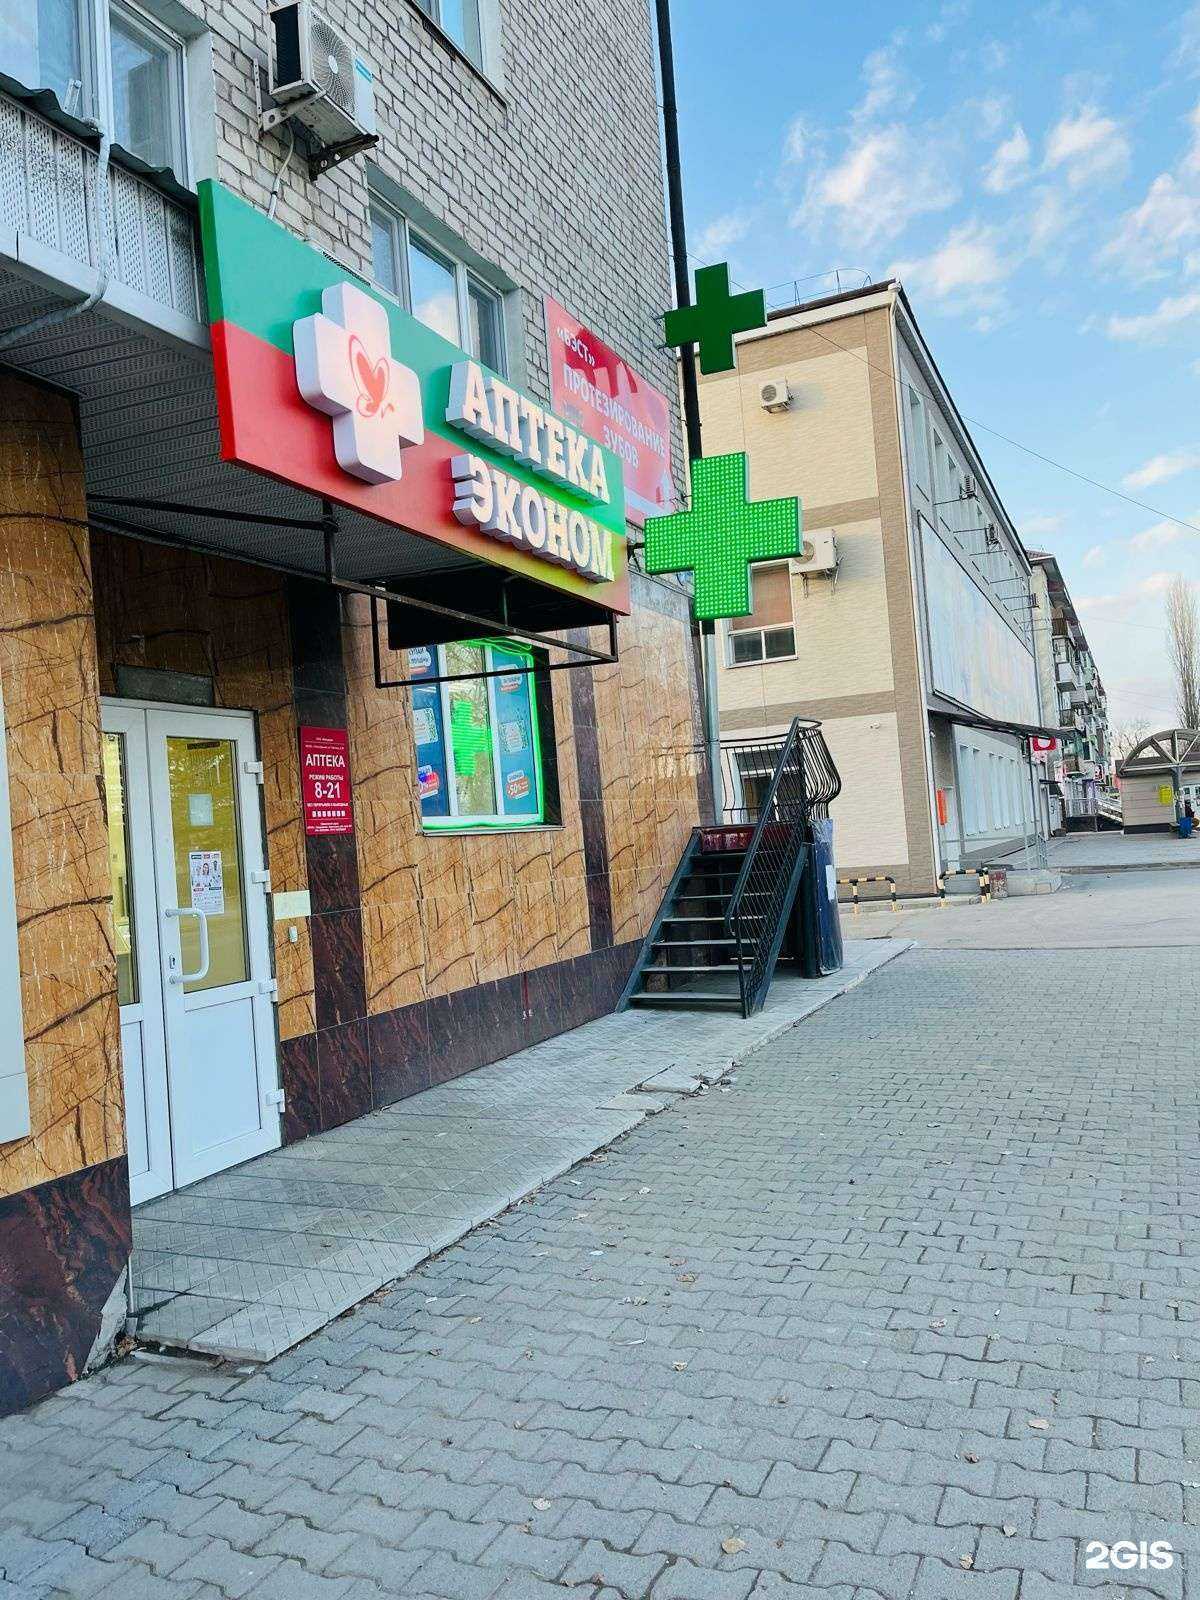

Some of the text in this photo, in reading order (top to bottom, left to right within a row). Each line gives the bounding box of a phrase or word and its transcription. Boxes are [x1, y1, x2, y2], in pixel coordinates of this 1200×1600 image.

[446, 360, 610, 504] АПТЕКА
[563, 363, 666, 457] ПРОТЕЗИРОВАНИЕ
[603, 425, 639, 468] ЗУБОВ
[450, 453, 615, 584] ЭКОНОМ
[306, 753, 346, 768] АПТЕКА
[314, 782, 341, 799] 8-21
